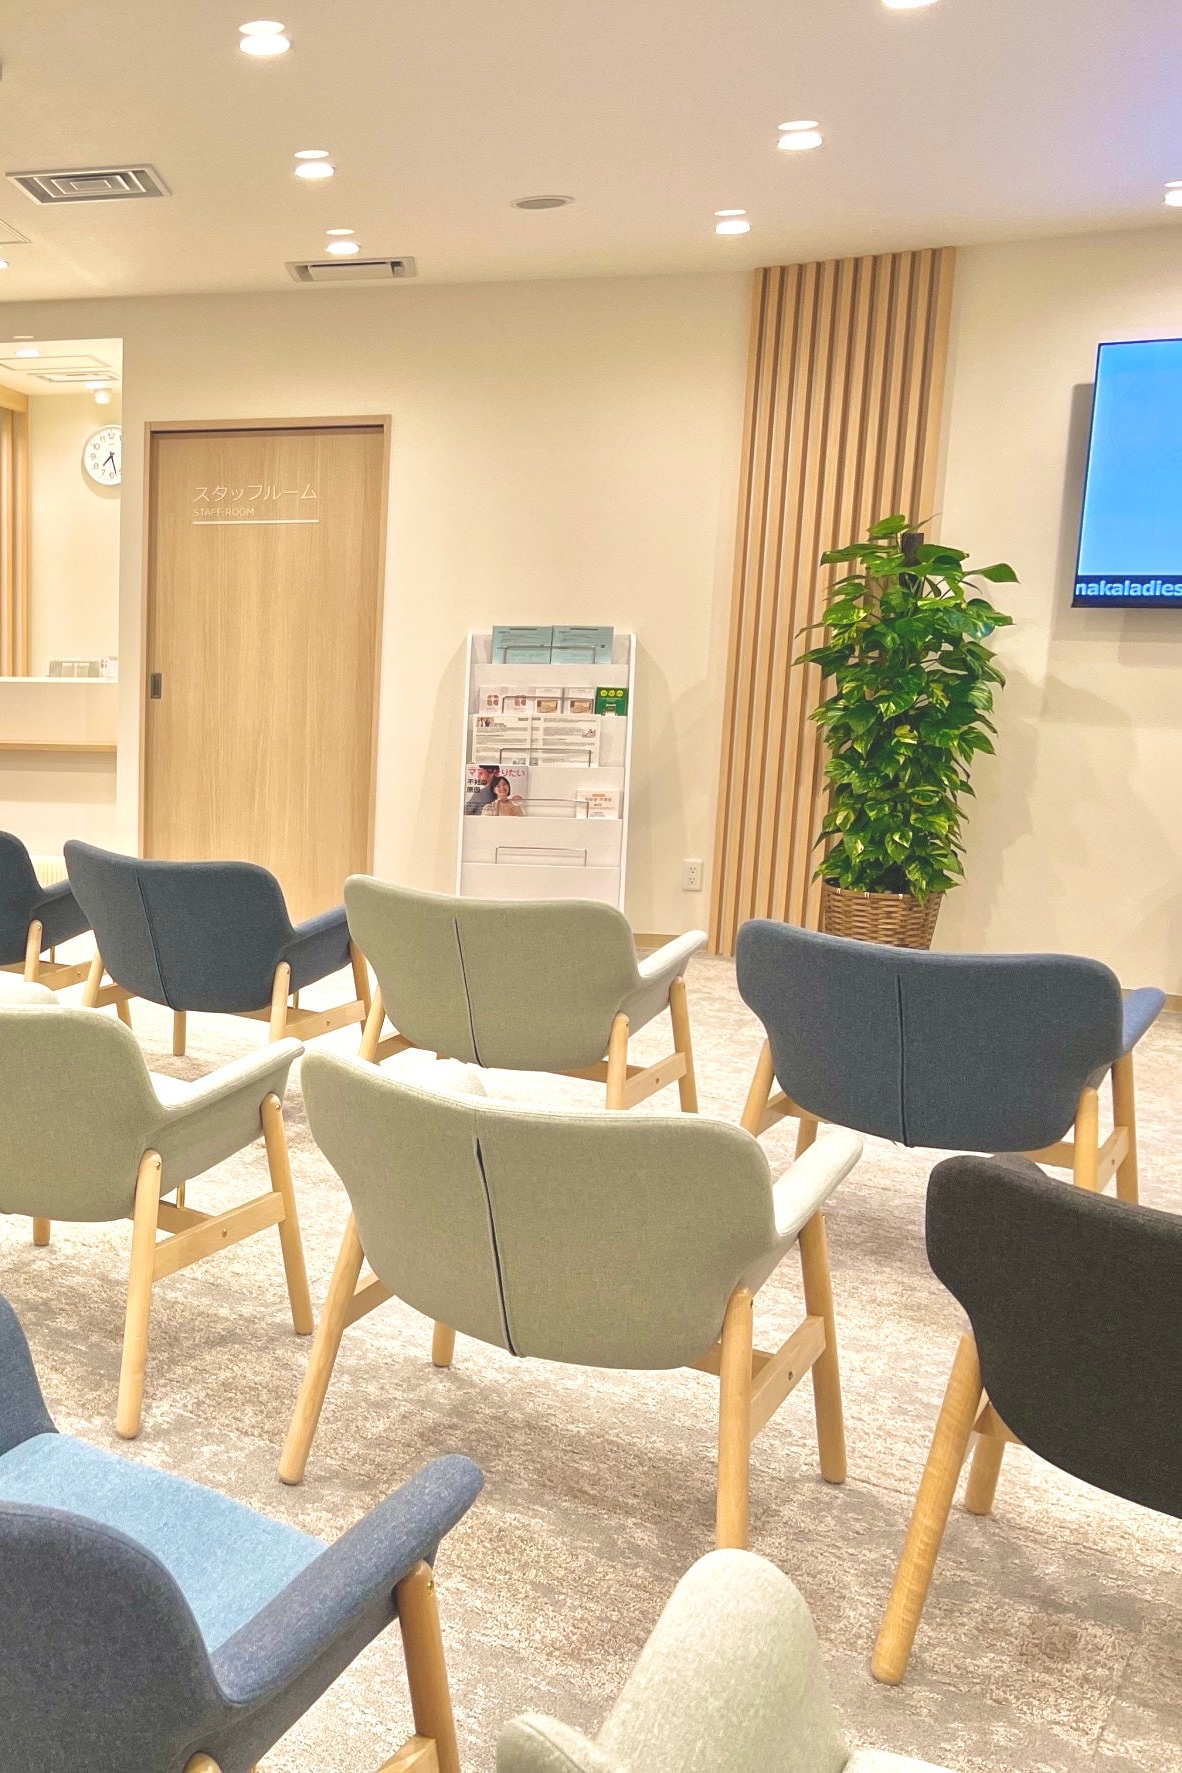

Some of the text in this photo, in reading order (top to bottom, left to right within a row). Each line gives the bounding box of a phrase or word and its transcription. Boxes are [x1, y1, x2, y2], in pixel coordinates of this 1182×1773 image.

[193, 483, 318, 502] スタッフルーム
[193, 507, 255, 517] STAFF ROOM
[1075, 580, 1182, 596] nakaladies
